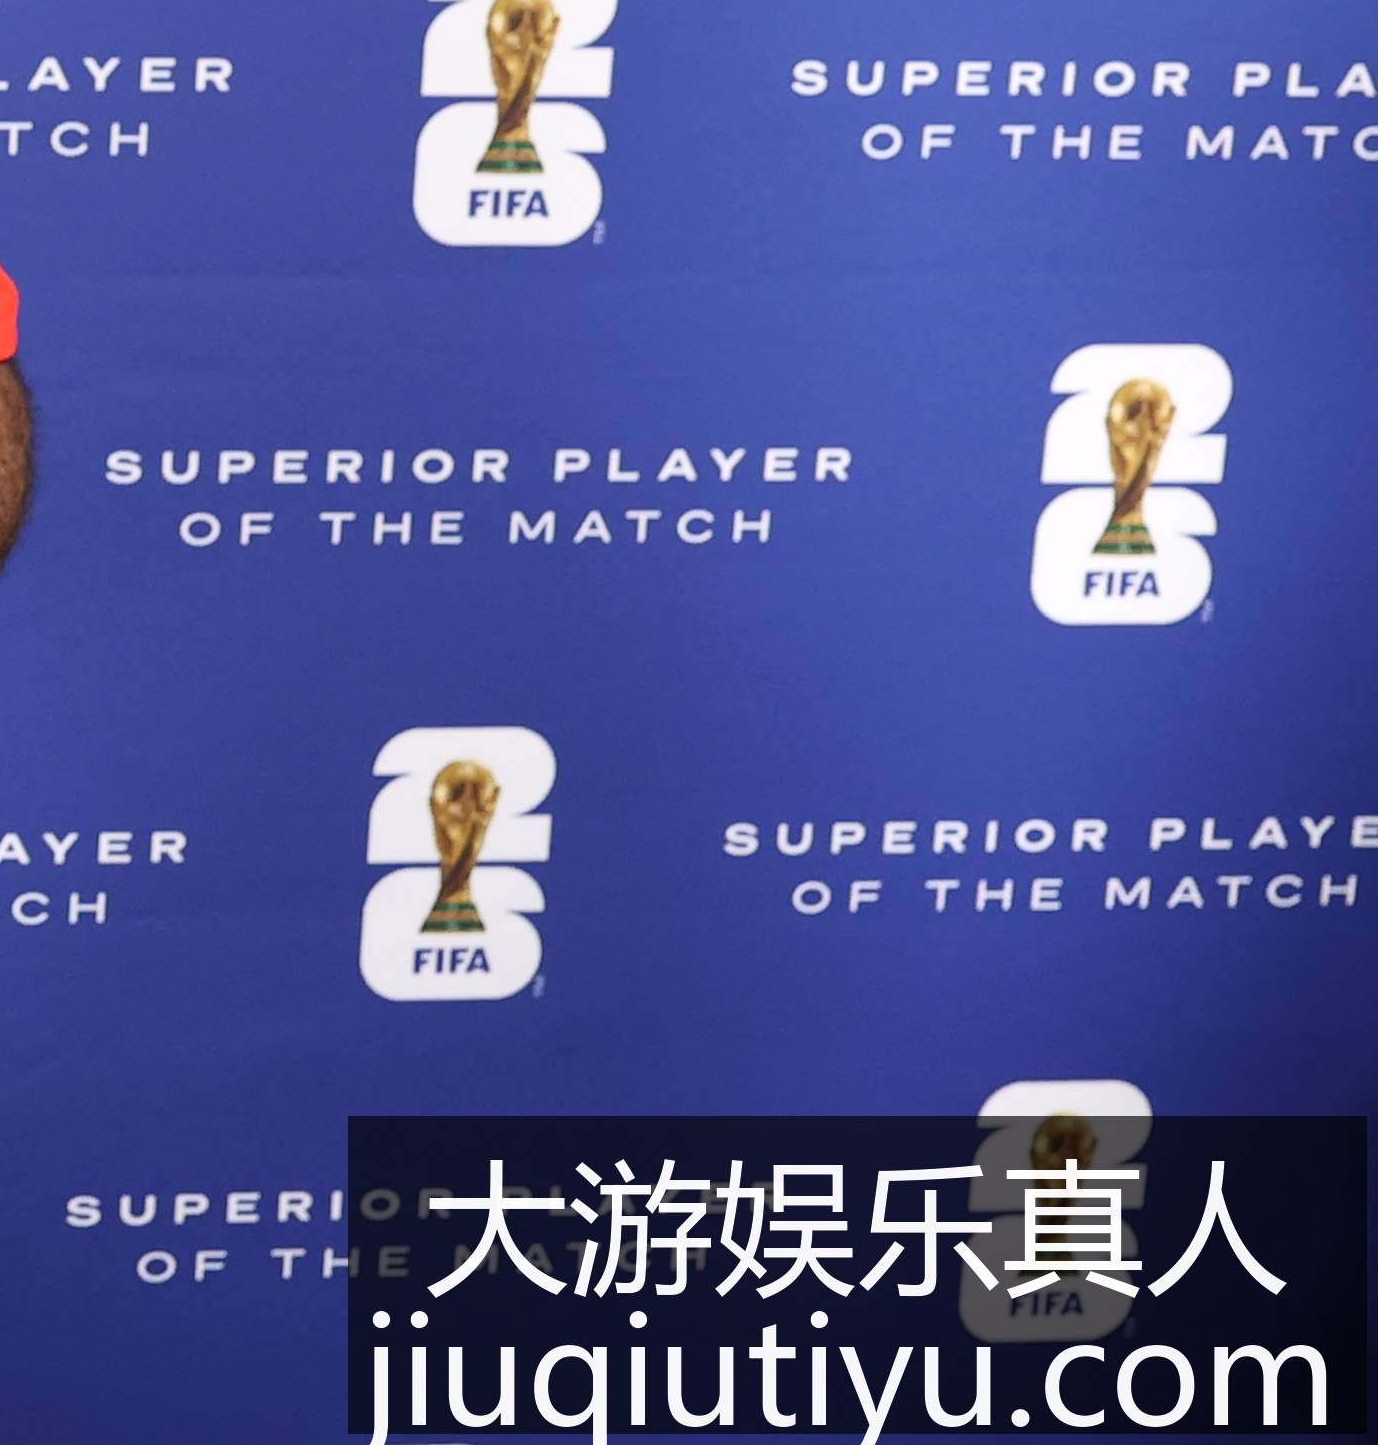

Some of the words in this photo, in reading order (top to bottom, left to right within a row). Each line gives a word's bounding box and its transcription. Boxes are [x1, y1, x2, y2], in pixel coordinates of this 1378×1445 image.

[789, 58, 1192, 99] SUPERIOR
[860, 122, 958, 162] OF
[997, 122, 1145, 162] THE
[467, 189, 550, 218] FIFA
[103, 446, 511, 487] SUPERIOR
[552, 445, 854, 485] PLAYER
[177, 510, 276, 549] OF
[317, 509, 466, 547] THE
[507, 507, 773, 546] MATCH
[1083, 570, 1160, 597] FIFA
[721, 817, 1110, 858] SUPERIOR
[790, 878, 884, 917] OF
[923, 876, 1065, 915] THE
[1103, 872, 1359, 912] MATCH
[412, 946, 491, 975] FIFA
[64, 1184, 453, 1229] SUPERIOR
[134, 1248, 230, 1285] OF
[268, 1243, 411, 1281] THE
